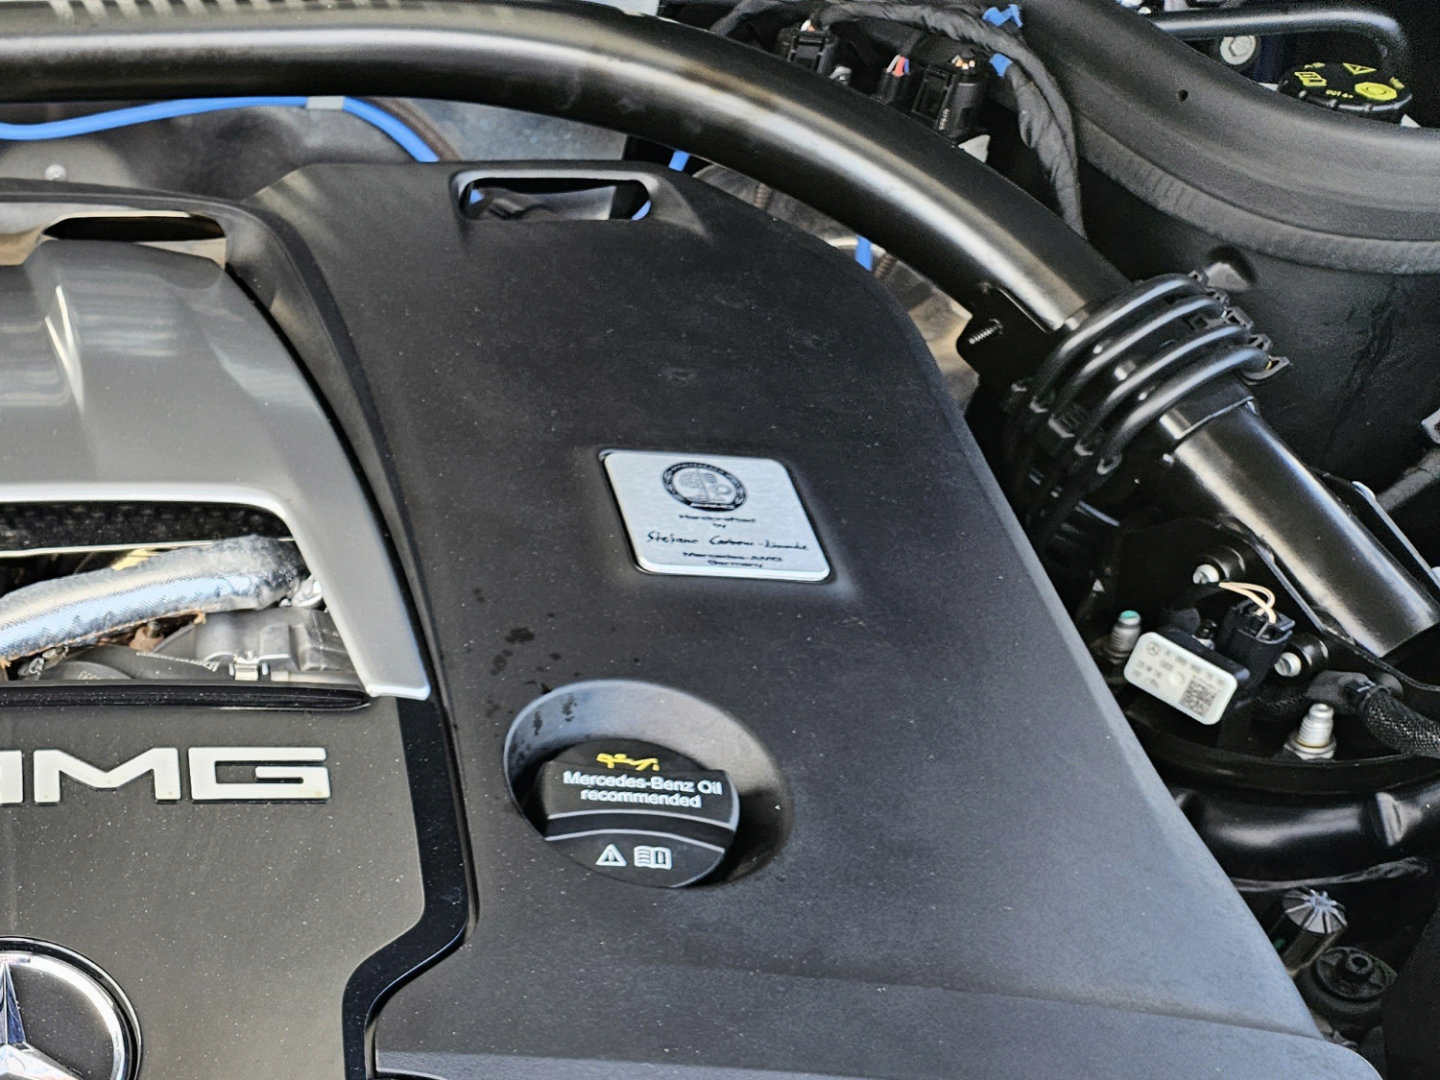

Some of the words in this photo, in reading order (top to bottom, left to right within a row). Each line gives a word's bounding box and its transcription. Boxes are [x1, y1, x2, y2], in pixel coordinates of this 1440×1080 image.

[563, 770, 695, 792] Mercedes-Benz
[697, 779, 723, 796] Oil
[580, 789, 702, 808] recommended
